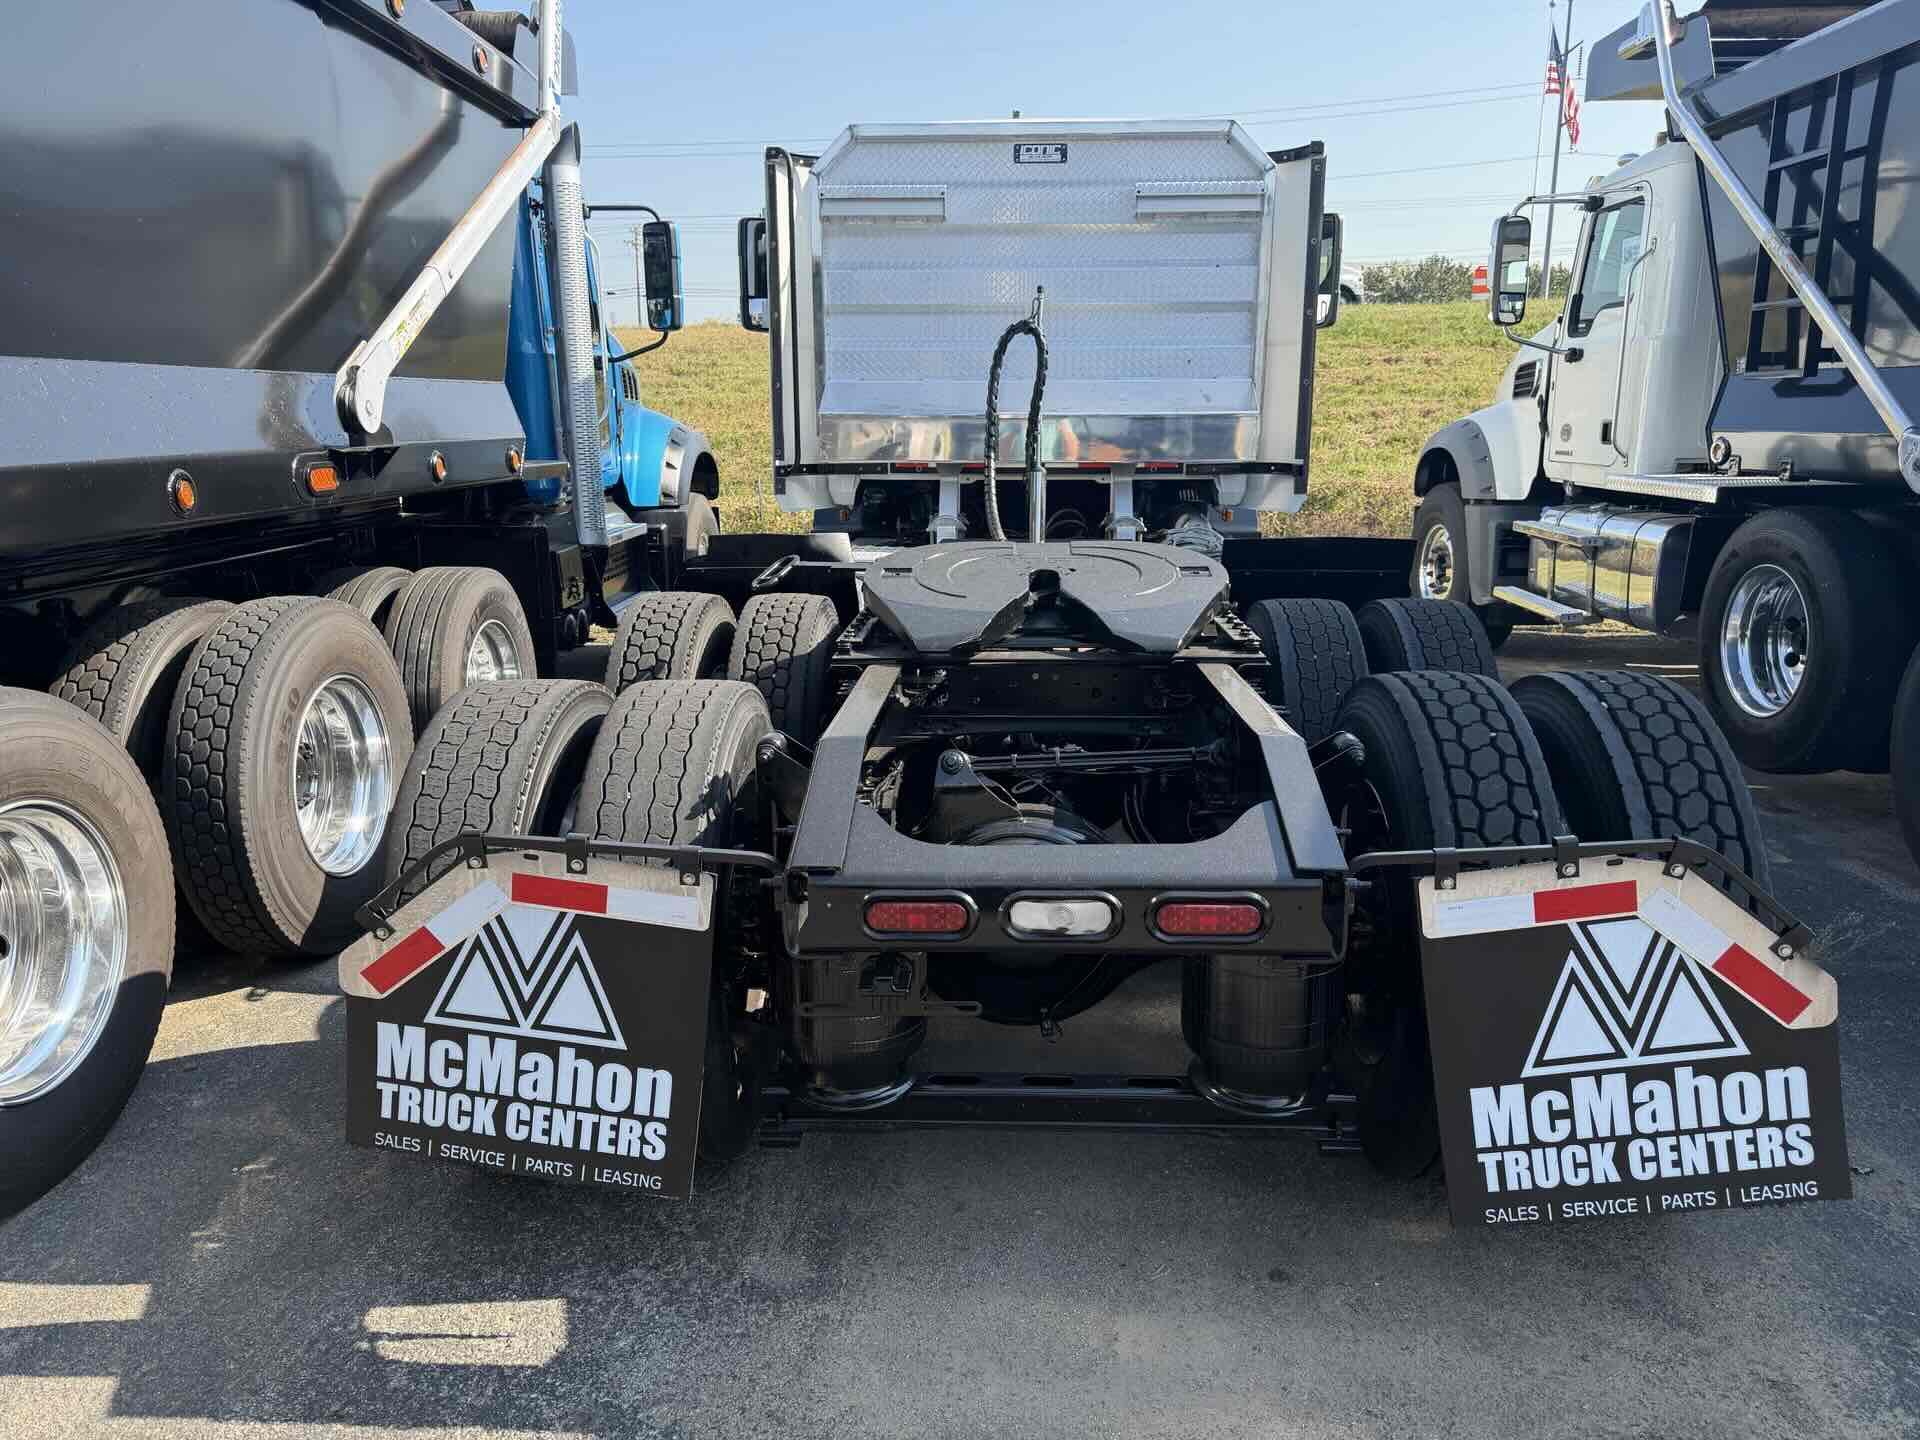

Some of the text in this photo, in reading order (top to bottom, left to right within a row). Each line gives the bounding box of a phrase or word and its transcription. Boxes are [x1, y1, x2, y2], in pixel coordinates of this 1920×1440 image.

[376, 1021, 672, 1118] McMahon
[376, 1082, 666, 1161] TRUCK CENTERS
[1470, 1066, 1810, 1148] McMahon
[375, 1133, 661, 1189] SALES SERVICE PARTS LEASING
[1477, 1124, 1814, 1192] TRUCK CENTERS
[1486, 1181, 1817, 1223] SALES SERVICE PARTS LEASING
